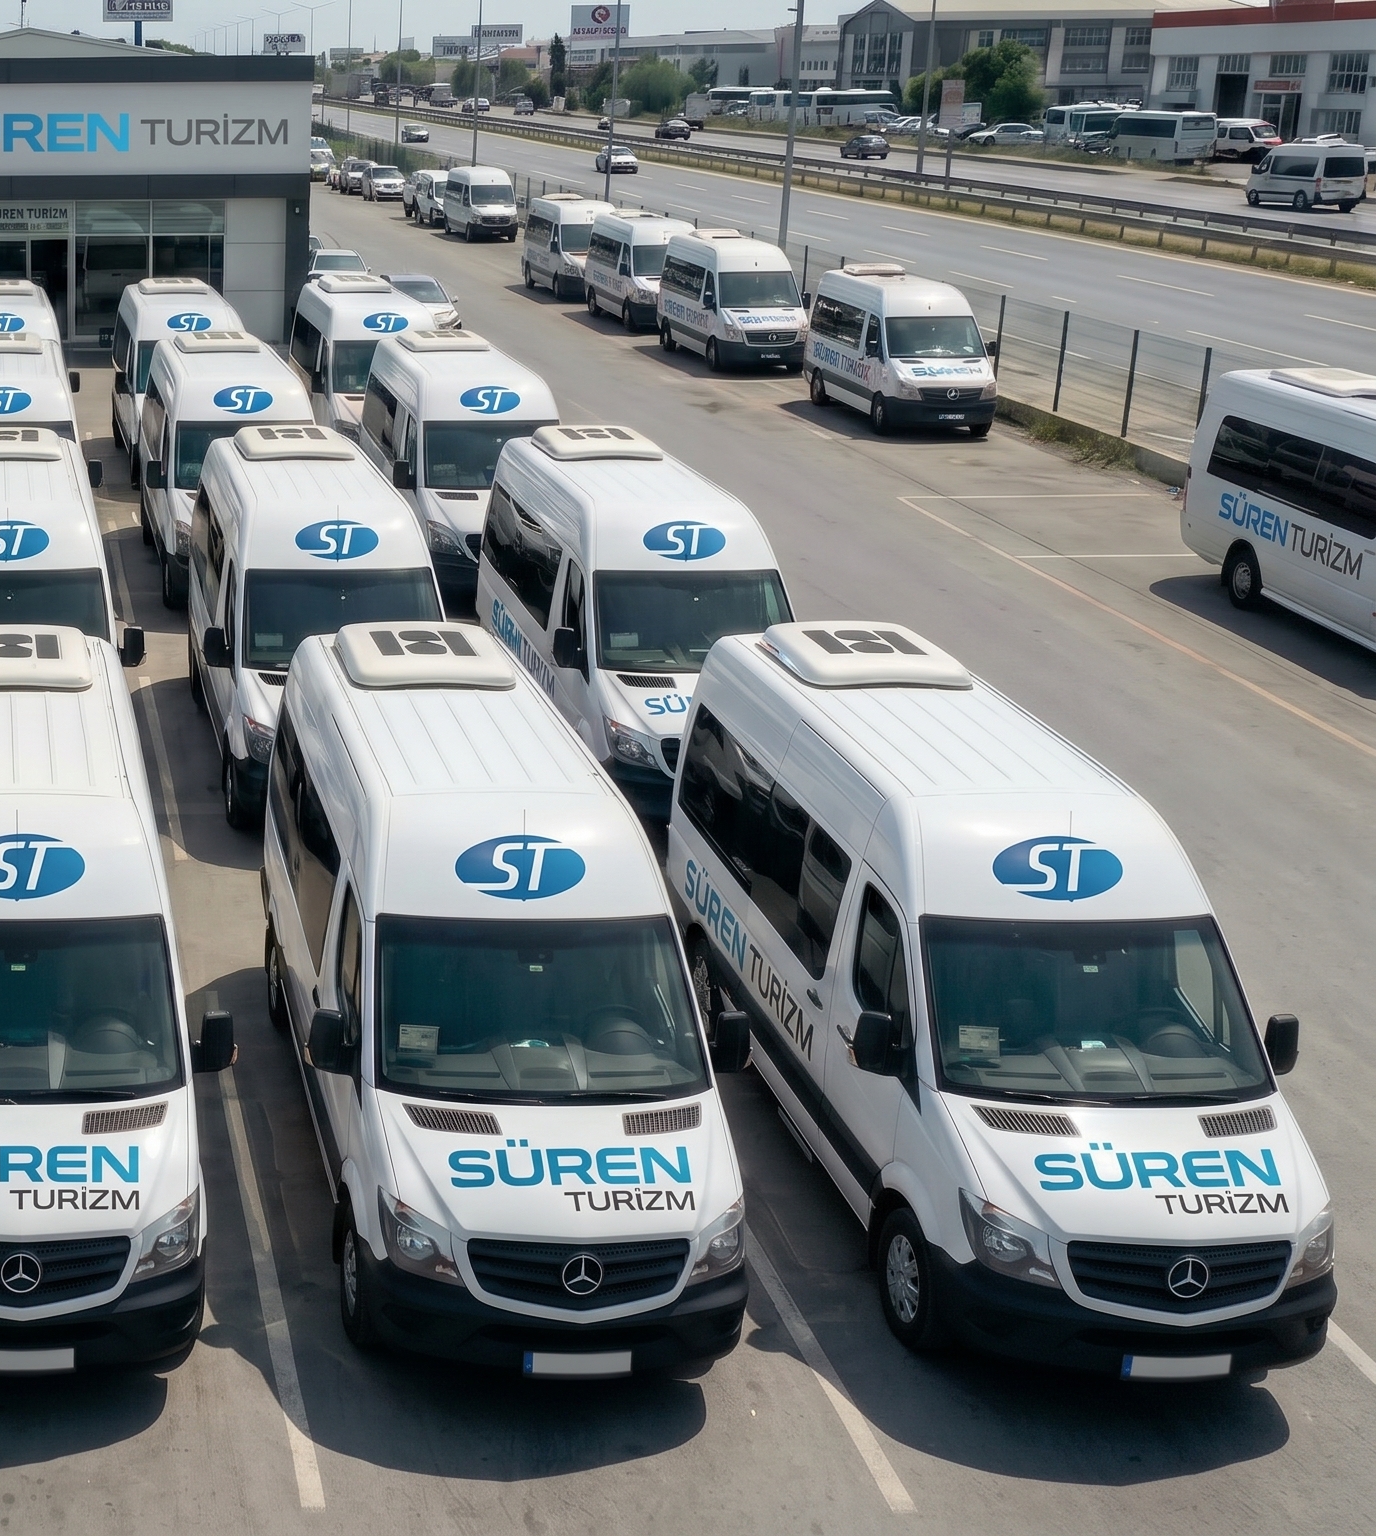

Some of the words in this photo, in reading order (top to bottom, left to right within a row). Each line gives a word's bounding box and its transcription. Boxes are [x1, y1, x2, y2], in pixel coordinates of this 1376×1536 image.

[141, 113, 288, 146] TURİZM
[170, 316, 208, 329] ST
[366, 317, 405, 331] ST
[217, 391, 269, 411] ST
[463, 391, 516, 411] ST
[299, 527, 372, 556] ST
[648, 527, 719, 556] ST
[1218, 491, 1289, 547] SÜREN
[1291, 523, 1364, 580] TURİZM
[644, 693, 692, 716] SÜ
[461, 843, 576, 891] ST
[999, 844, 1114, 892] ST
[685, 858, 747, 973] SÜREN
[750, 943, 814, 1062] TURİZM
[448, 1139, 692, 1188] SÜREN
[1034, 1142, 1281, 1191] SÜREN
[9, 1186, 140, 1211] TURİZM
[563, 1187, 696, 1212] TURİZM
[1155, 1190, 1290, 1215] TURİZM
